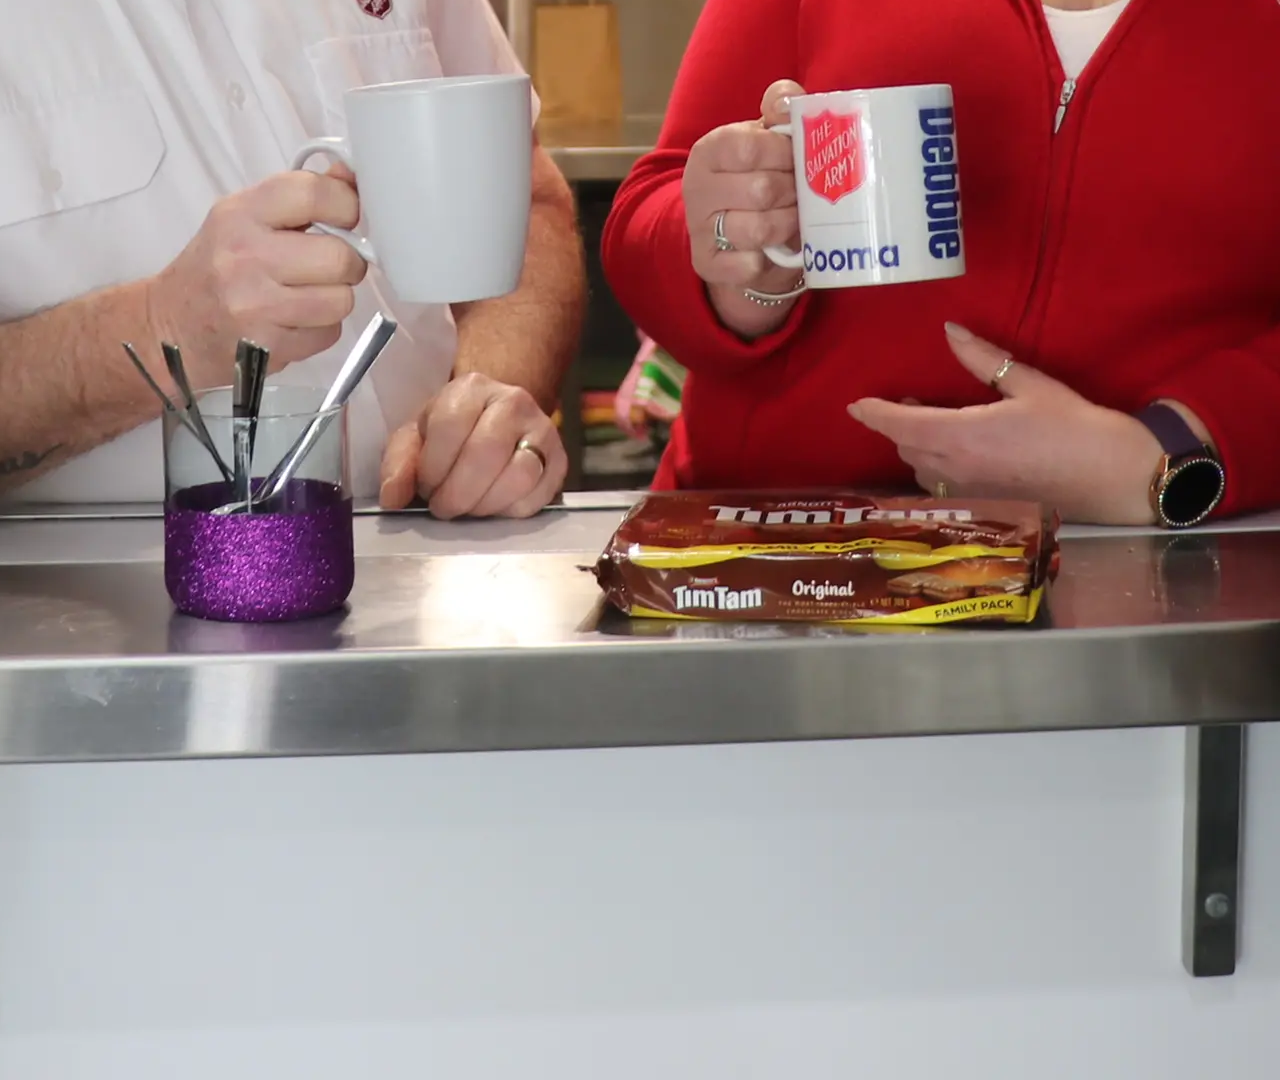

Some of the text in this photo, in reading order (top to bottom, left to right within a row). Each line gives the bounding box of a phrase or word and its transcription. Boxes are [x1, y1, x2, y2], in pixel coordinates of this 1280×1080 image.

[810, 120, 833, 149] THE
[806, 121, 859, 183] SALVATION
[823, 149, 858, 194] ARMY
[918, 106, 962, 261] Debbie
[803, 243, 900, 273] Cooma
[791, 579, 856, 601] Original
[934, 599, 1015, 618] FAMILY PACK
